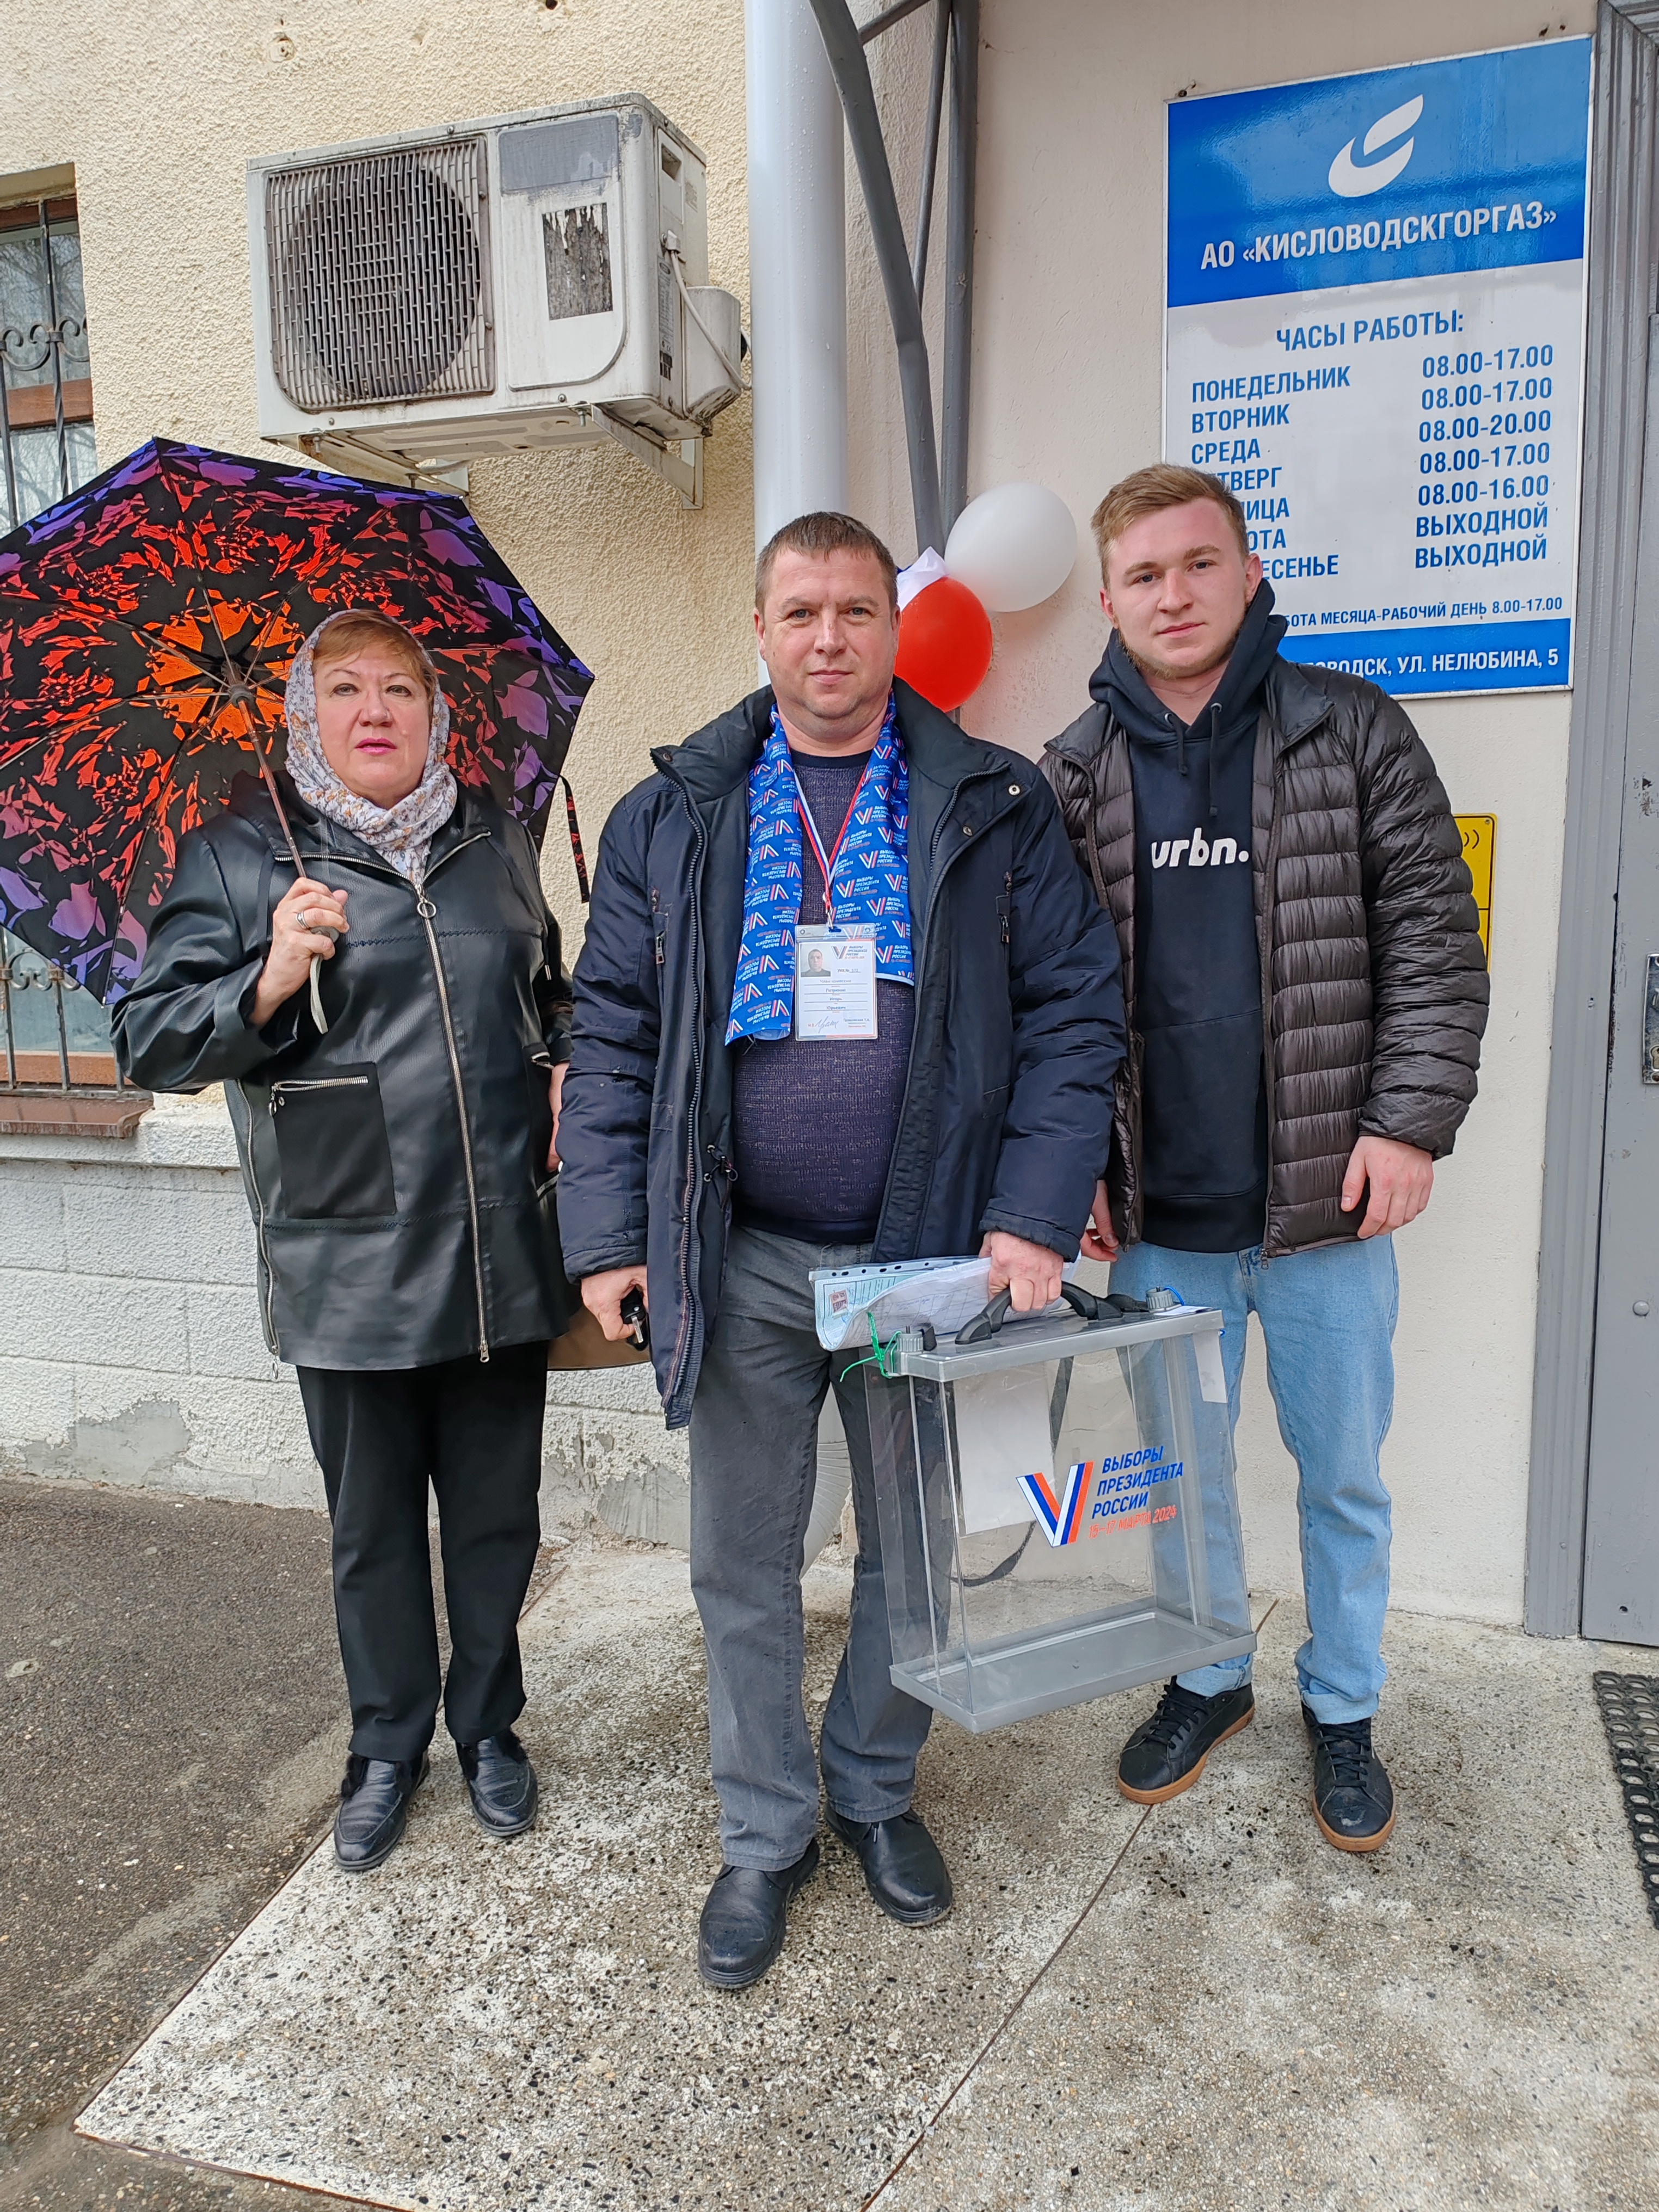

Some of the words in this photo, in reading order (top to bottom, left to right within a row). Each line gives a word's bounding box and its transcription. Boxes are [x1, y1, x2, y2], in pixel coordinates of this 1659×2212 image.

[1201, 242, 1234, 270] АО
[1242, 200, 1557, 263] «КИСЛОВОДСКГОРГАЗ»
[1276, 322, 1345, 352] ЧАСЫ
[1354, 310, 1464, 343] РАБОТЫ:
[1422, 345, 1553, 378] 08.00-17.00
[1191, 365, 1351, 403] ПОНЕДЕЛЬНИК
[1421, 377, 1553, 410] 08.00-17.00
[1191, 404, 1290, 434] ВТОРНИК
[1419, 409, 1551, 443] 08.00-20.00
[1190, 438, 1261, 465] СРЕДА
[1419, 441, 1550, 474] 08.00-17.00
[1214, 466, 1282, 491] ТВЕРГ
[1418, 474, 1549, 506] 08.00-16.00
[1415, 506, 1548, 538] ВЫХОДНОЙ
[1261, 554, 1339, 581] ЕСЕНЬЕ
[1414, 538, 1547, 570] ВЫХОДНОЙ
[1320, 601, 1446, 625] МЕСЯЦА-РАБОЧИЙ
[1450, 602, 1487, 619] ДЕНЬ
[1492, 597, 1563, 614] 8.00-17.00
[1397, 655, 1427, 674] УЛ.
[1432, 649, 1543, 672] НЕЛЮБИНА,
[1548, 648, 1559, 666] 5
[1151, 827, 1249, 869] urbn.
[1102, 1445, 1164, 1474] ВЫБОРЫ
[1096, 1461, 1184, 1497] ПРЕЗИДЕНТА
[1092, 1491, 1149, 1520] РОССИИ
[1153, 1504, 1177, 1524] 2024
